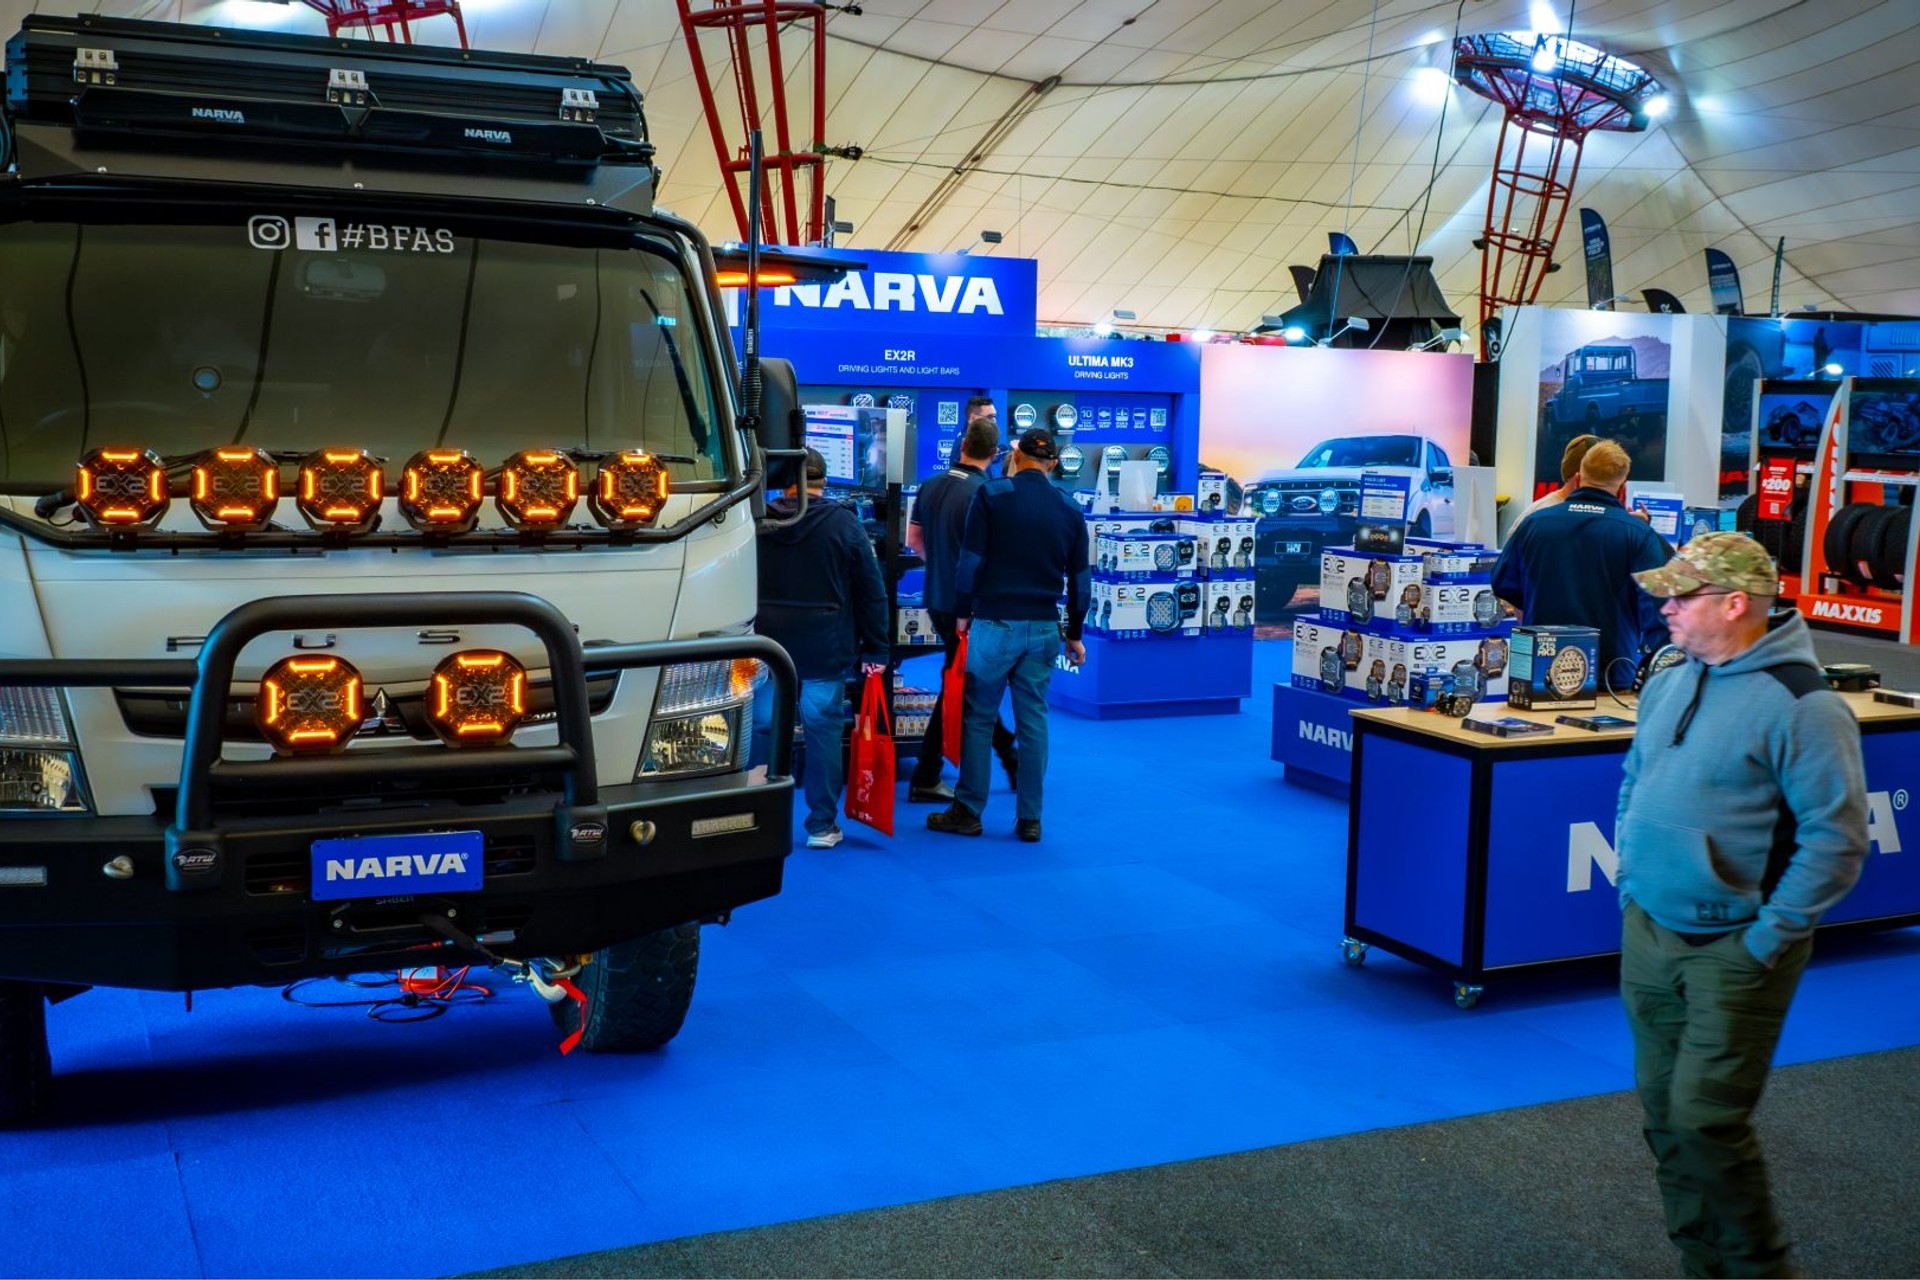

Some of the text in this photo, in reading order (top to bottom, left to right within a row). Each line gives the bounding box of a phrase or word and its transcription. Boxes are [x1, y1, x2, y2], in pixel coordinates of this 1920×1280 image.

[192, 107, 244, 120] NARVA
[464, 128, 511, 140] NARVA
[341, 223, 454, 253] #BFAS
[774, 270, 1004, 315] NARVA
[884, 350, 916, 361] EX2R
[1068, 355, 1134, 368] ULTIMA MK3
[838, 364, 960, 376] DRIVING LIGHTS AND LIGHT BARS
[1074, 370, 1129, 380] DRIVING LIGHTS
[1762, 478, 1791, 491] $200
[1568, 503, 1606, 512] NARVA
[1439, 587, 1470, 604] EX2
[1812, 600, 1883, 624] MAXXIS
[1414, 643, 1446, 662] EX2
[1299, 719, 1354, 753] NARV
